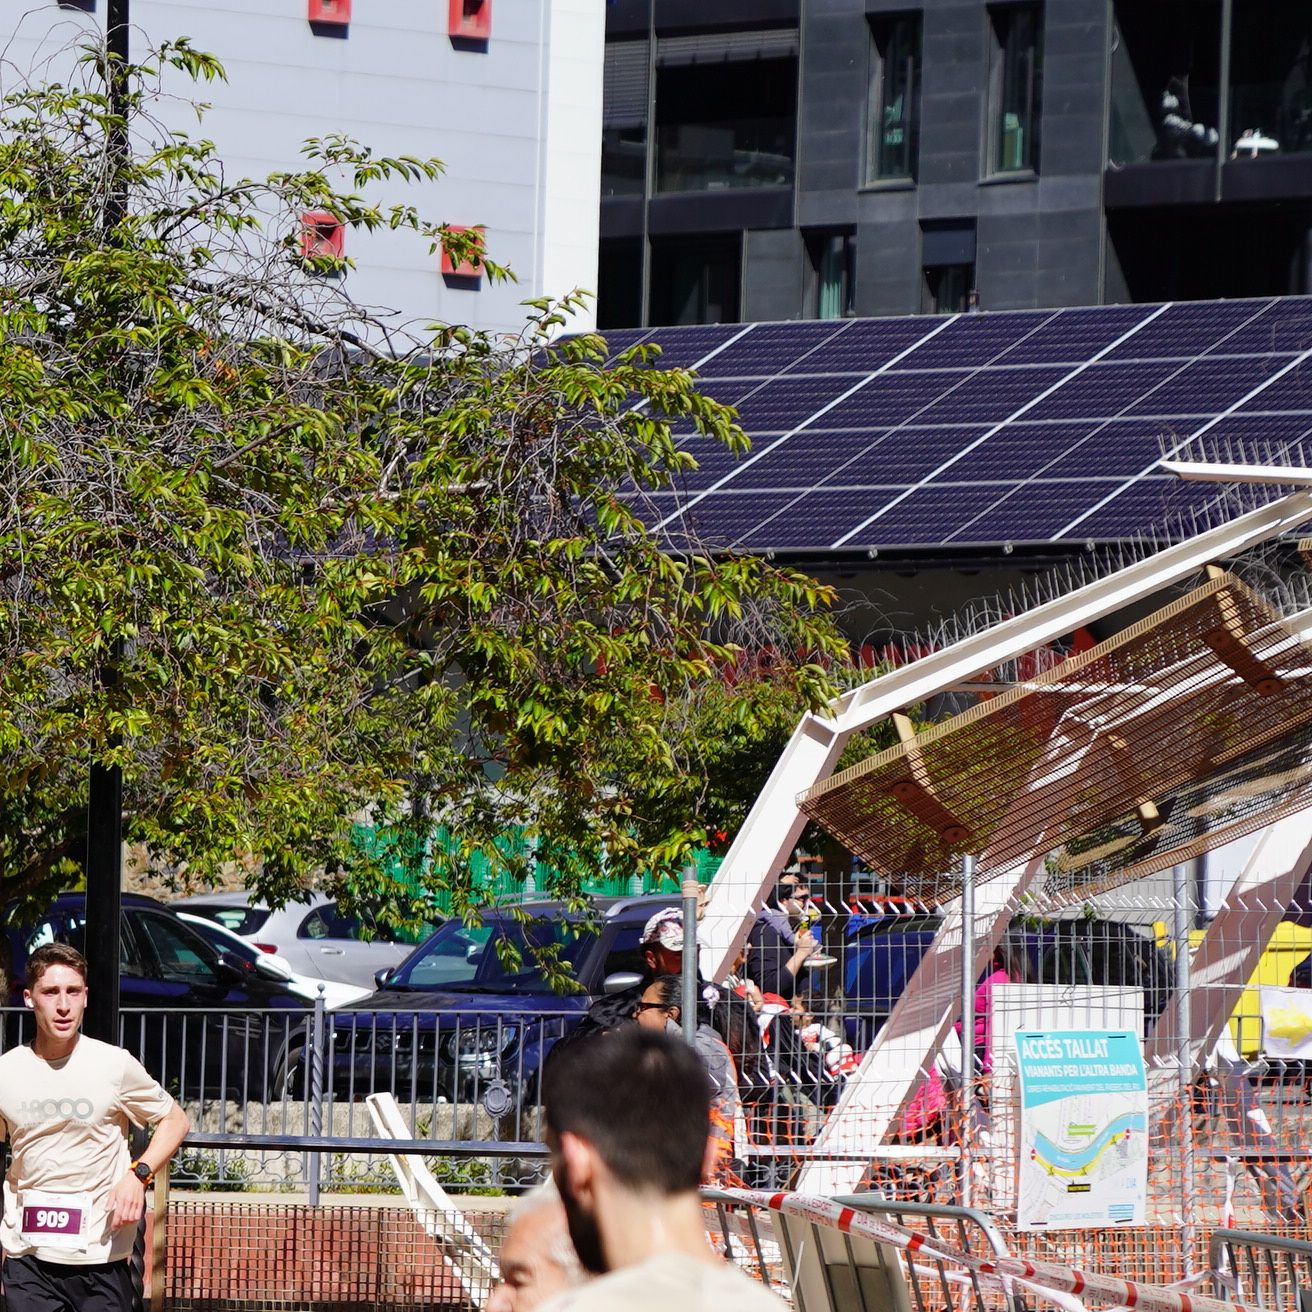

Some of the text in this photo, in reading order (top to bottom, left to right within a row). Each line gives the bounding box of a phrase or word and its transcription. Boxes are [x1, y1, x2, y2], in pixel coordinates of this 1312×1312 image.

[1023, 1035, 1109, 1059] ACCÉS TALLAT
[1024, 1062, 1138, 1078] VIANANTS PER L'ALTRA BANDA
[36, 1210, 70, 1228] 909
